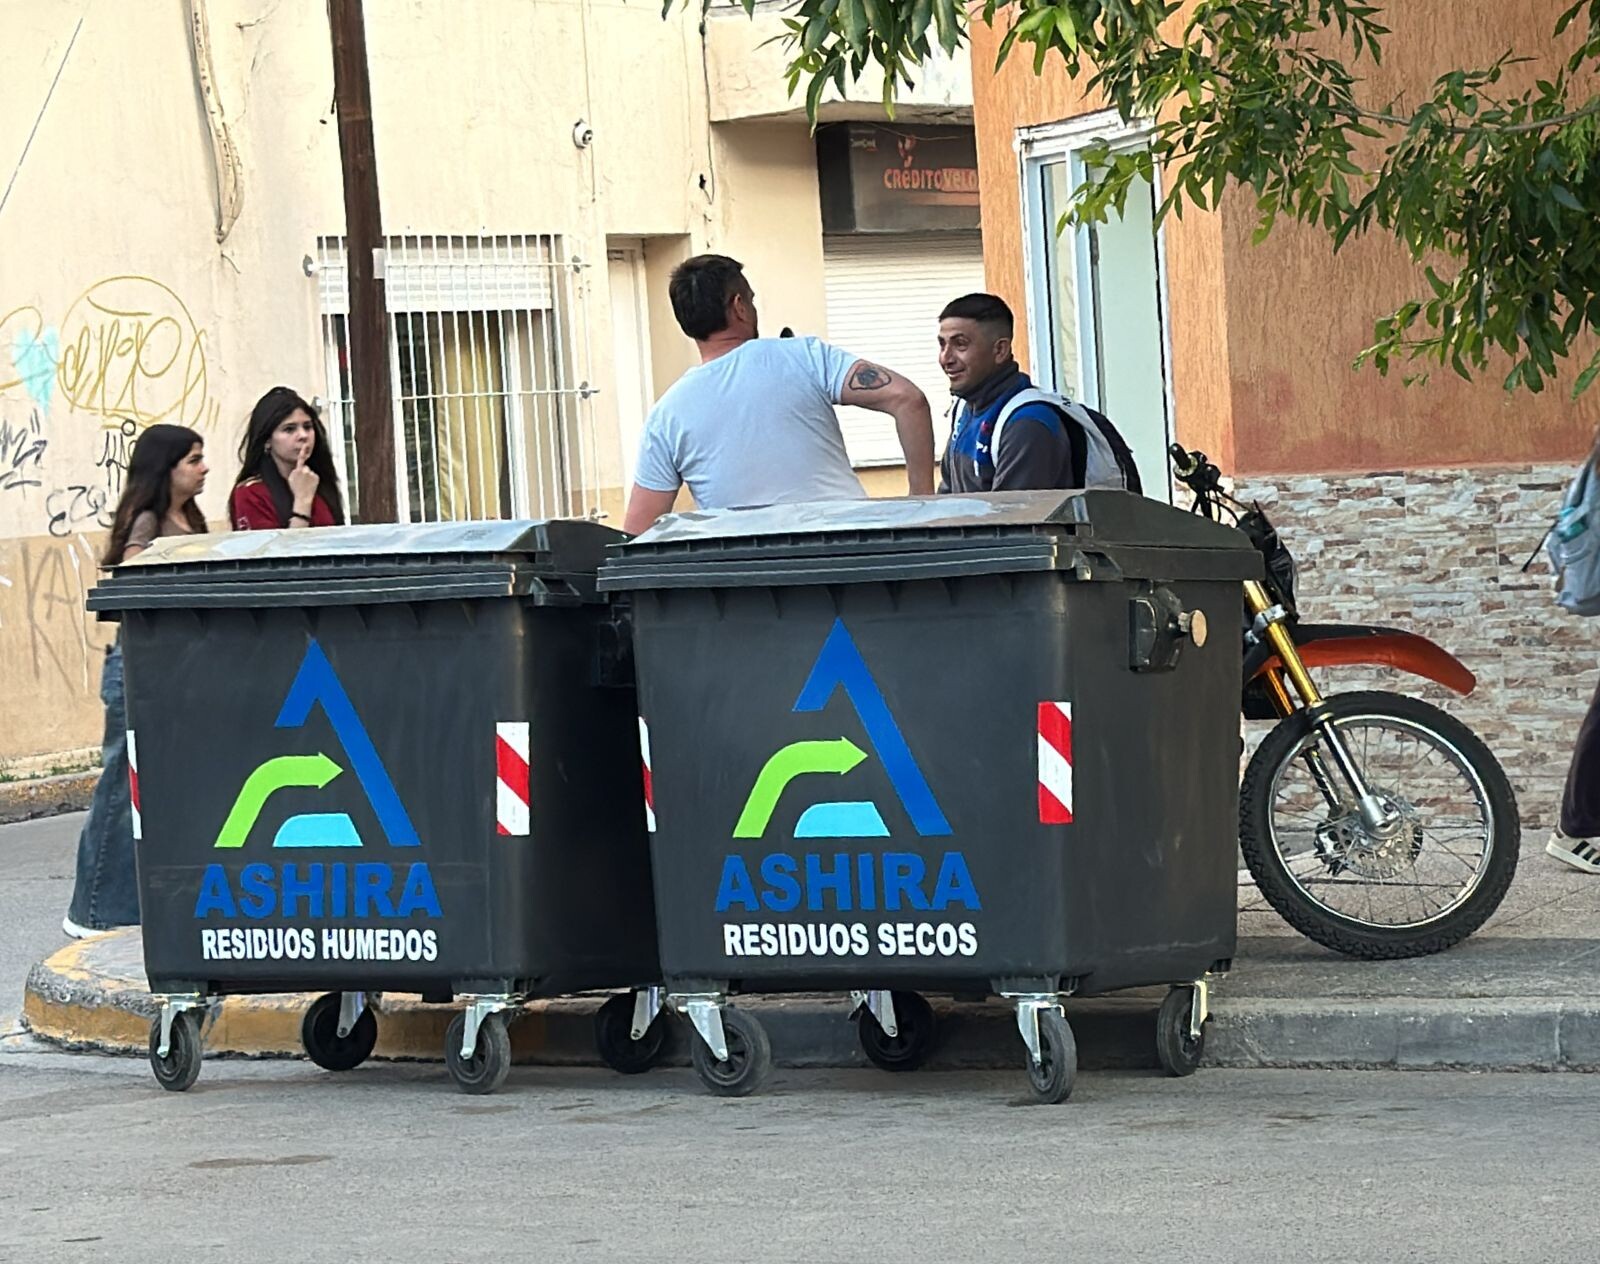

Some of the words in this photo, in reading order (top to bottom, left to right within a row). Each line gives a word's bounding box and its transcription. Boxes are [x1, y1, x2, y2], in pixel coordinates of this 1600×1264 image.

[194, 862, 443, 919] ASHIRA
[714, 852, 982, 912] ASHIRA
[201, 927, 316, 960] RESIDUOS
[322, 928, 438, 961] HUMEDOS
[723, 923, 870, 956] RESIDUOS
[877, 922, 978, 956] SECOS
